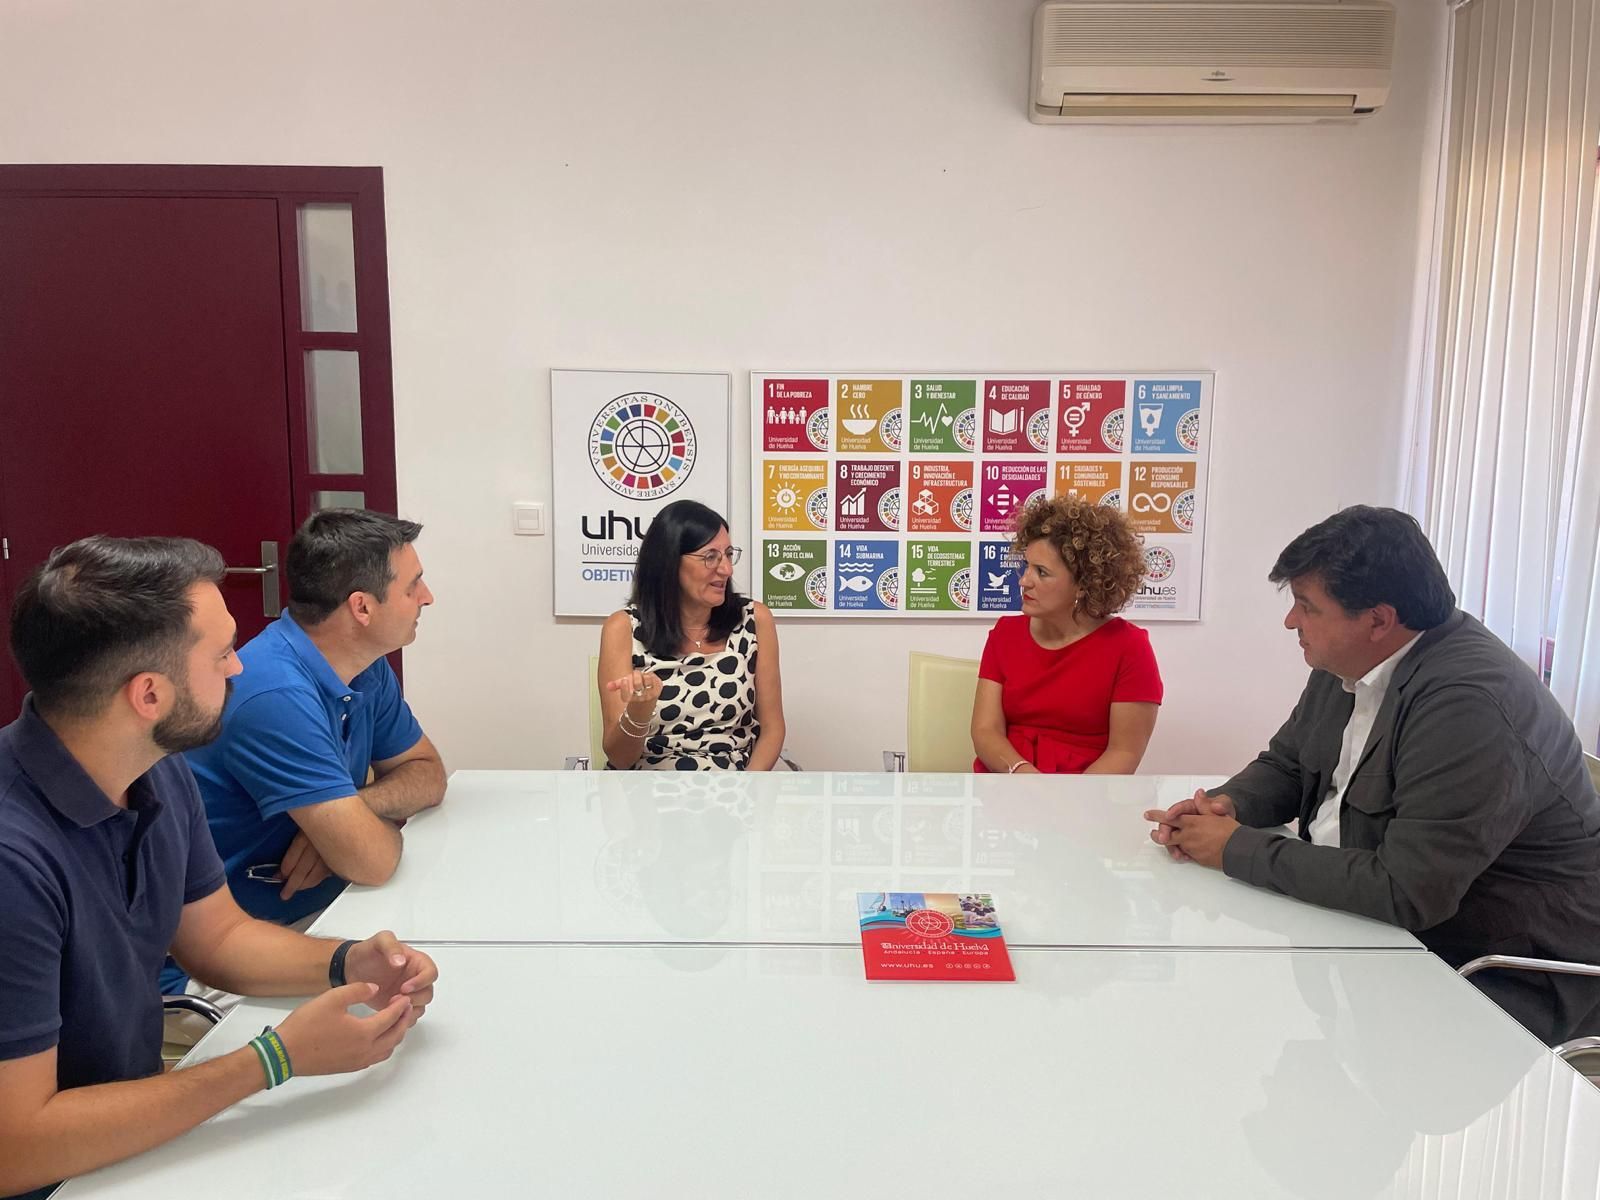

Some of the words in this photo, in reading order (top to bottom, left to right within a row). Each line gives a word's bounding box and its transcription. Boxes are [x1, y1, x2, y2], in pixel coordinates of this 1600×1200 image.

[881, 942, 937, 950] Universidad
[940, 942, 952, 950] de
[954, 943, 989, 951] Huelva
